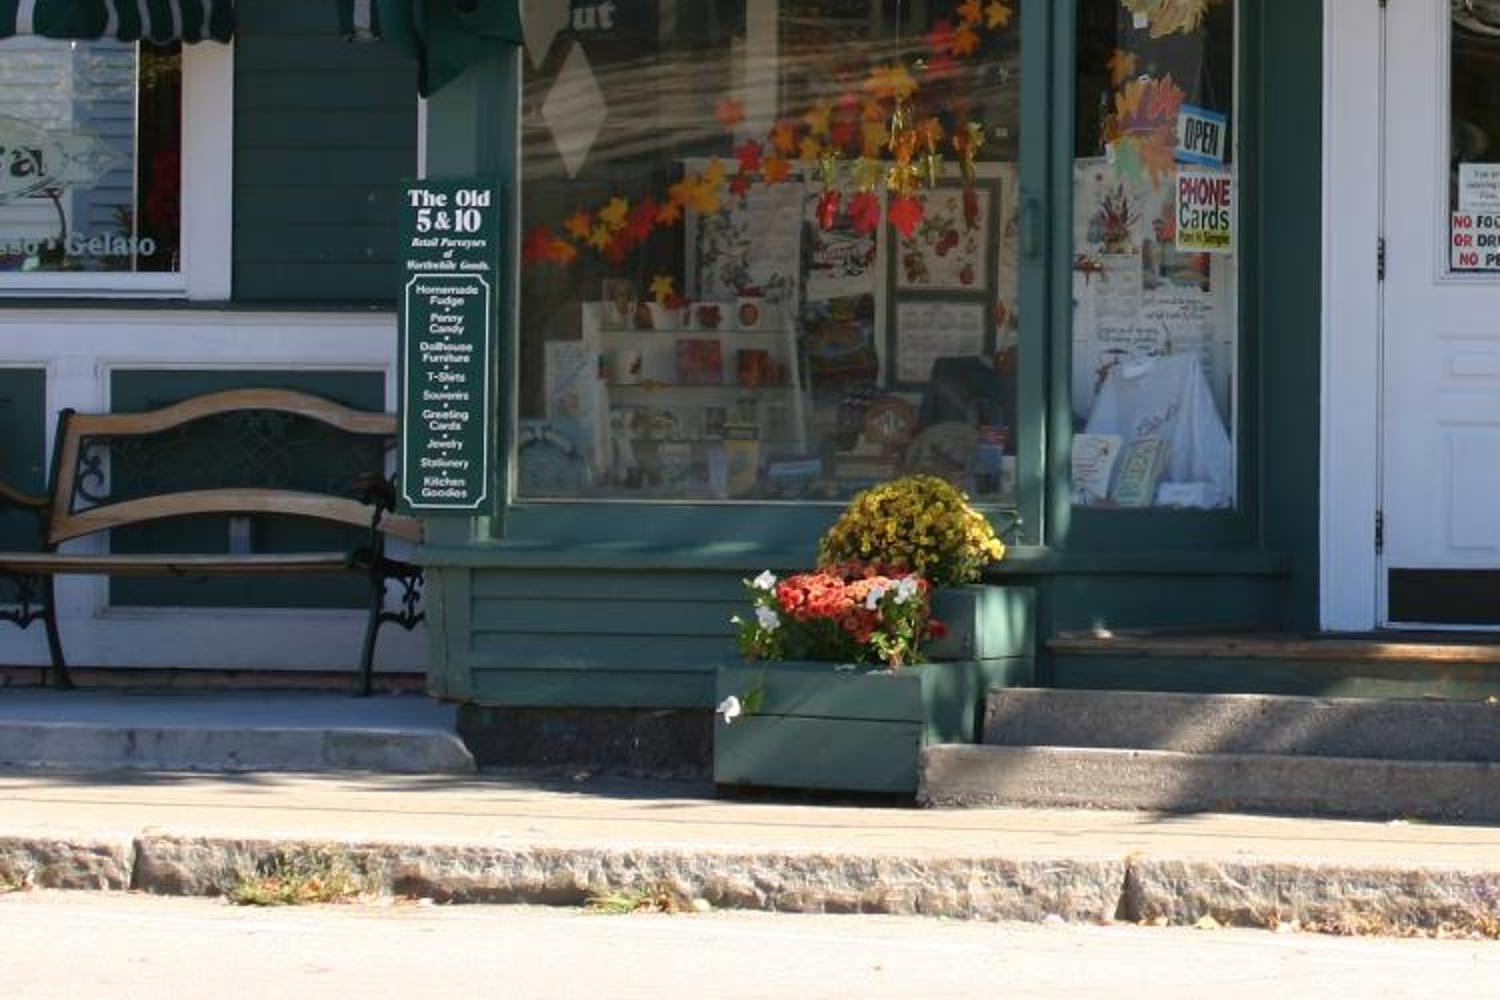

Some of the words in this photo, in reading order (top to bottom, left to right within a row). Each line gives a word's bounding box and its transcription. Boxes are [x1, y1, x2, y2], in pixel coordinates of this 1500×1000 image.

[1184, 116, 1219, 156] OPEN
[1178, 177, 1231, 206] PHONE
[407, 189, 448, 207] The
[455, 189, 491, 207] Old
[1178, 202, 1230, 231] Cards
[1453, 216, 1472, 229] NO
[65, 232, 156, 256] Gelato
[1453, 234, 1472, 247] OR
[1459, 253, 1478, 266] NO
[416, 285, 479, 295] Homemade
[429, 296, 464, 307] Fudge
[429, 313, 464, 324] Penny
[429, 324, 464, 335] Candy
[419, 342, 473, 351] Dollhouse
[422, 353, 470, 363] Furniture
[426, 372, 465, 383] T-Shirts
[423, 390, 469, 400] Souvenirs
[422, 409, 469, 421] Greeting
[429, 421, 461, 431] Cards
[426, 439, 463, 450] Jewelry
[420, 457, 469, 469] Stationery
[423, 476, 465, 486] Kitchen
[421, 488, 468, 498] Goodies
